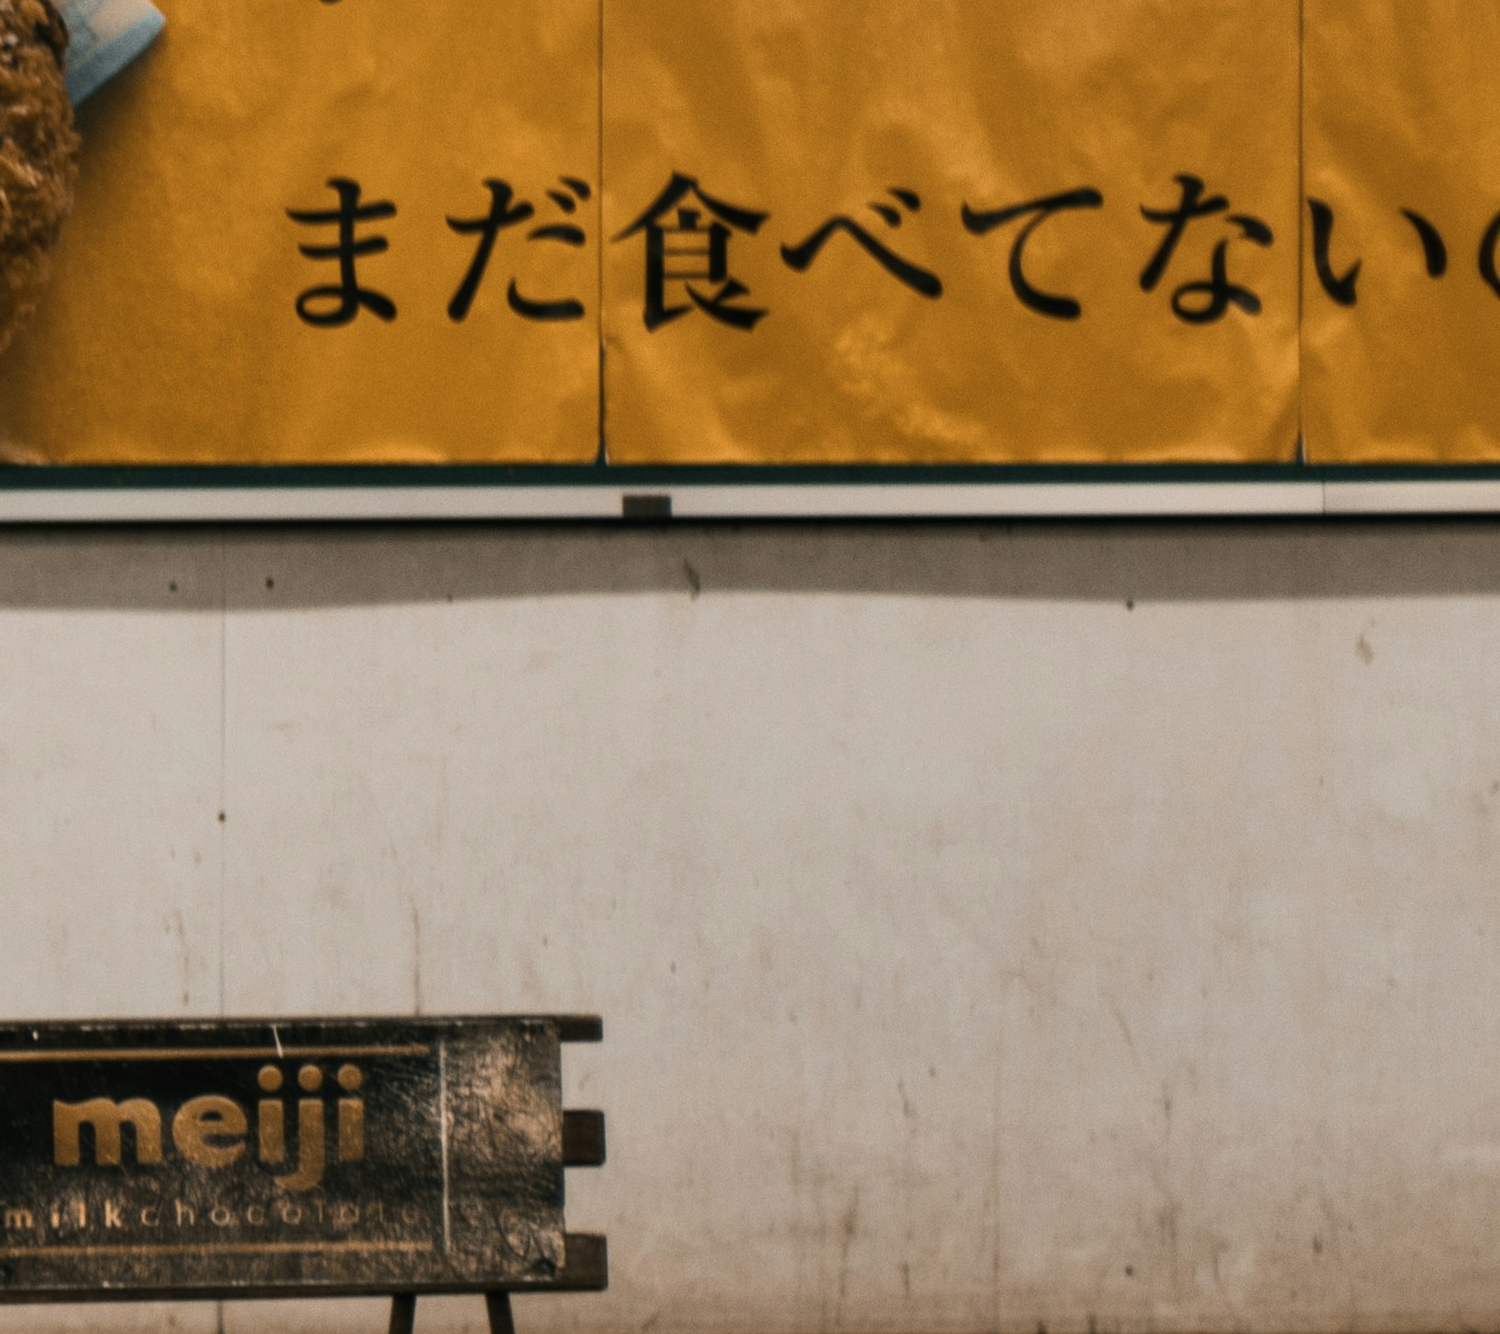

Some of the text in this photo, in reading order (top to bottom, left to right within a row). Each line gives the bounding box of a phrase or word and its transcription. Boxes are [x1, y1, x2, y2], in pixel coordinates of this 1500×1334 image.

[285, 170, 1500, 334] まだ食べてない
[51, 1063, 366, 1192] meiji
